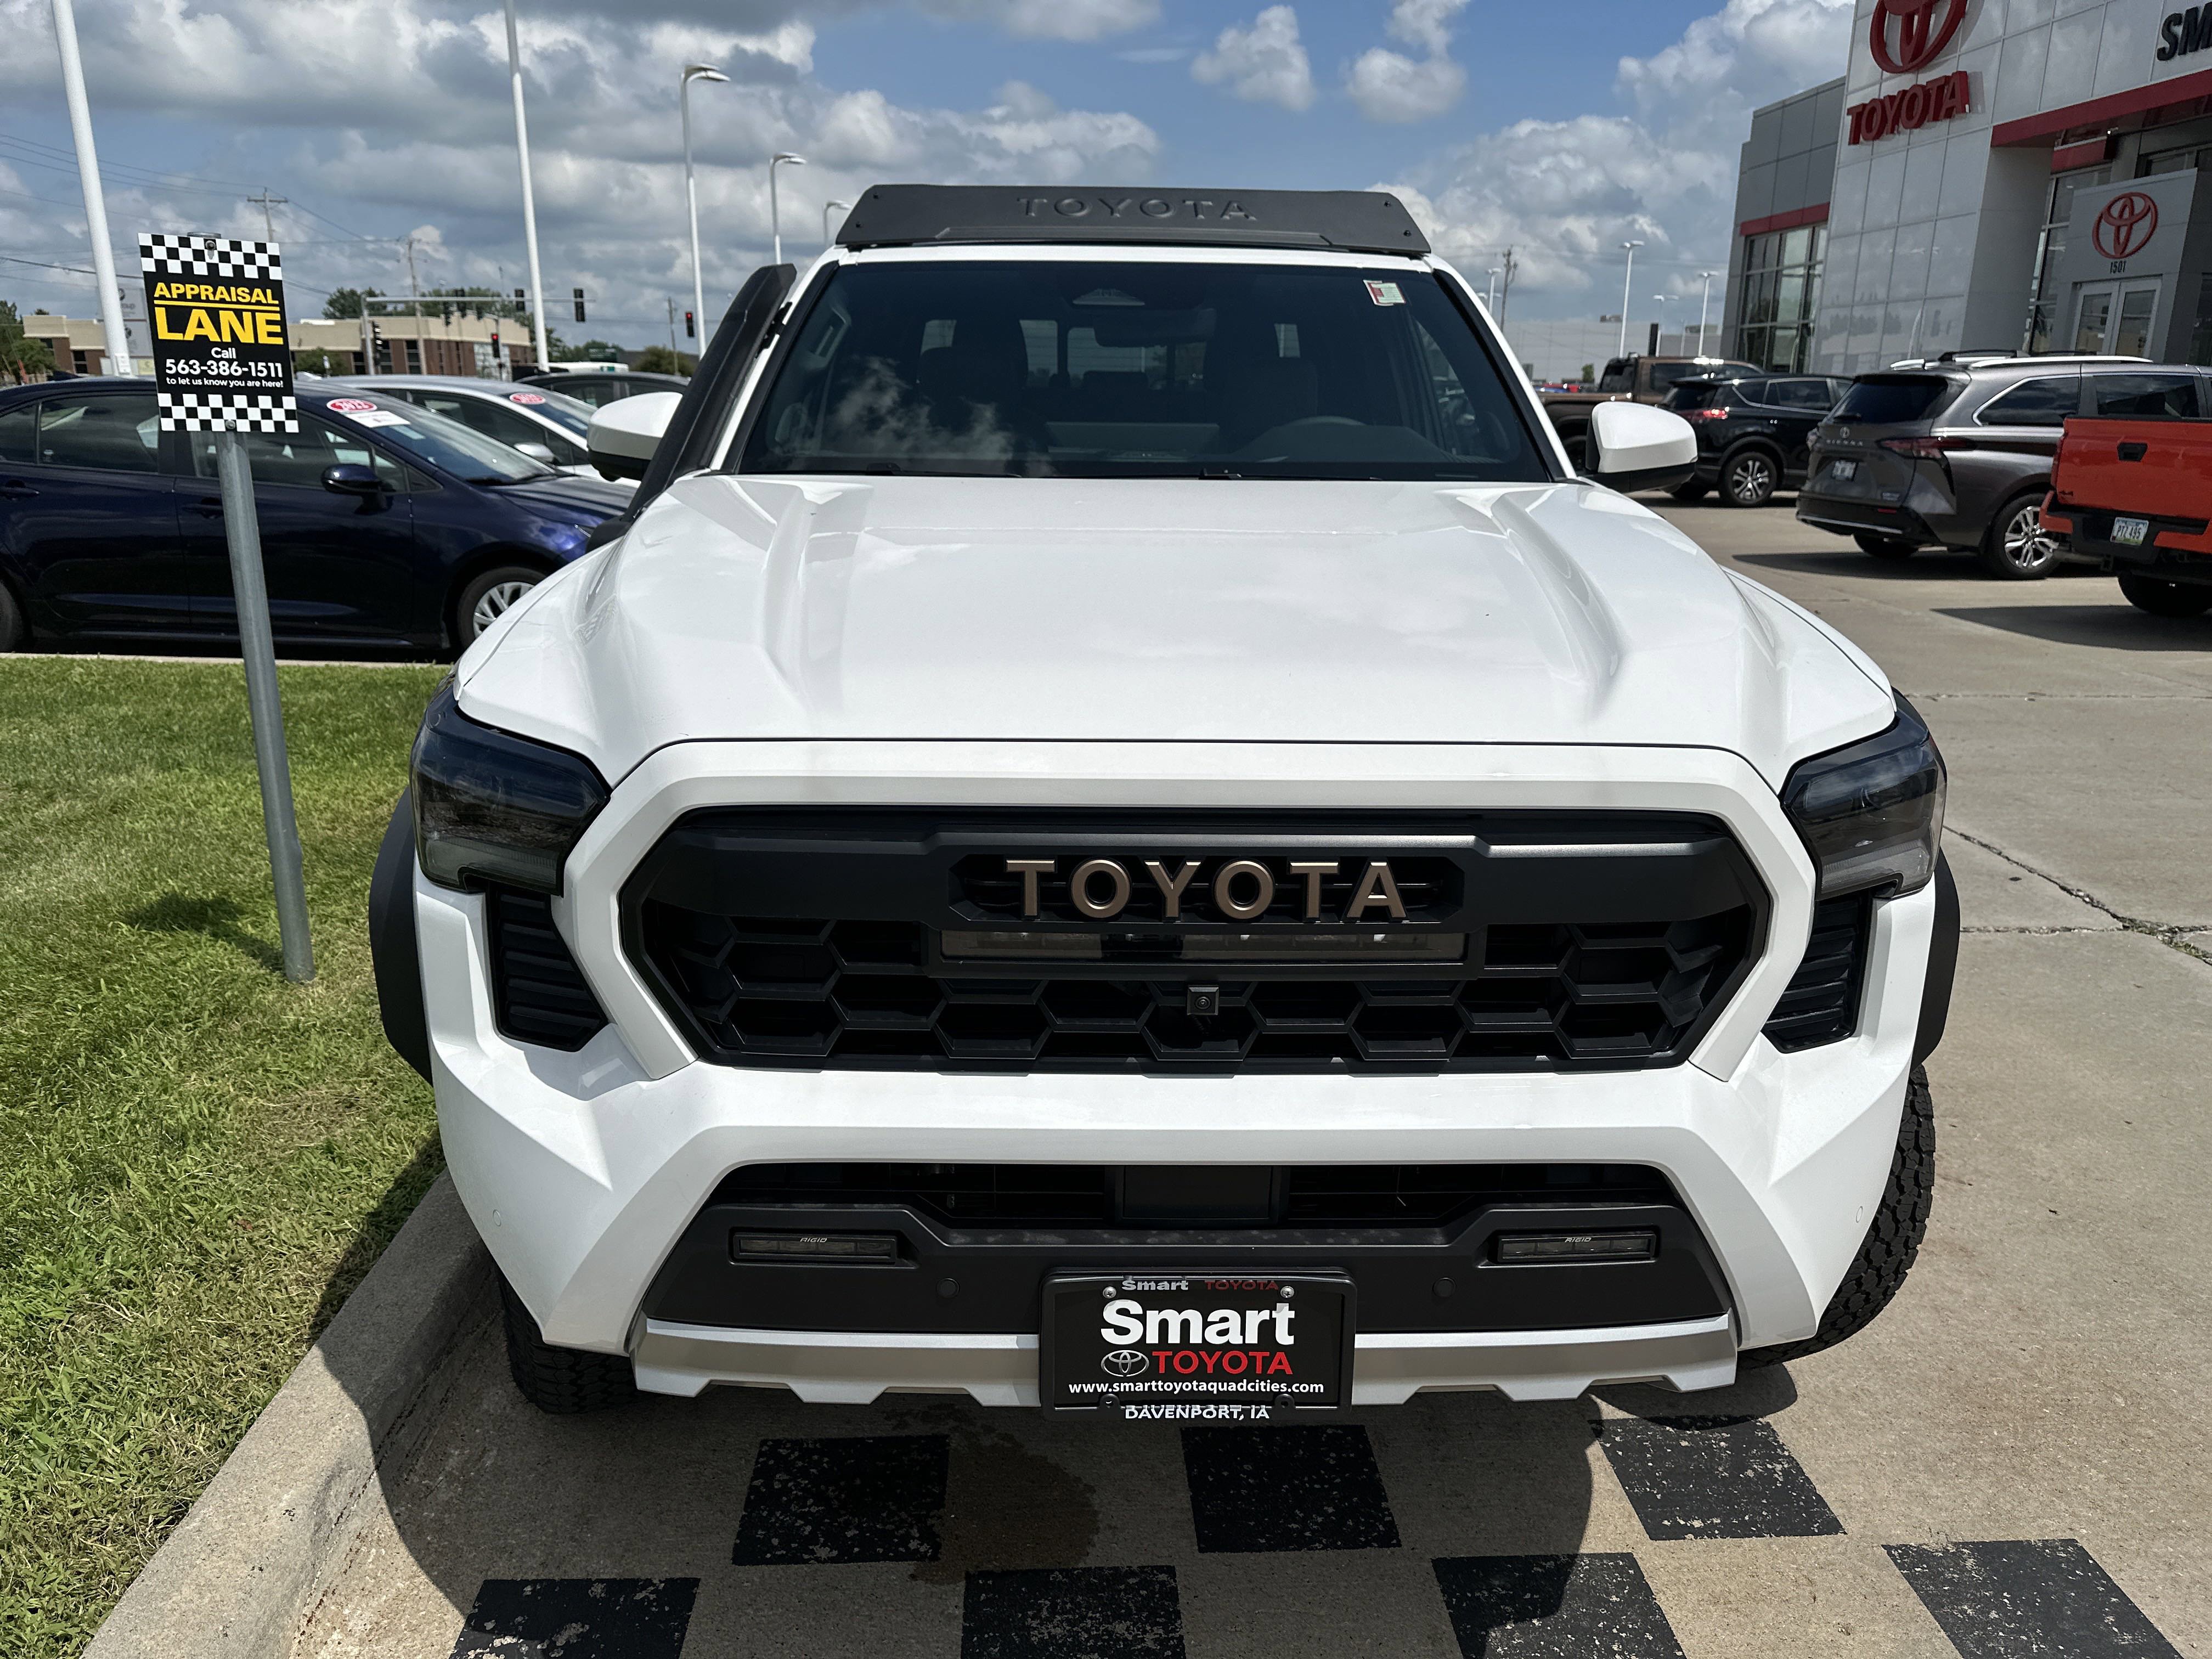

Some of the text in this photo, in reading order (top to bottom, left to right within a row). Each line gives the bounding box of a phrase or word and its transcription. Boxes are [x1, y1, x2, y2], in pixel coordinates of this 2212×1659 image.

[1847, 71, 1970, 145] TOYOTA
[1017, 198, 1257, 220] TOYOTA
[2110, 260, 2127, 274] 1501
[154, 282, 279, 304] APPRAISAL
[155, 307, 284, 345] LANE
[211, 347, 236, 359] Call
[166, 359, 283, 377] 563-386-1511
[204, 377, 228, 386] know
[1005, 860, 1406, 919] TOYOTA
[1122, 1280, 1279, 1290] Smart TOYOTA
[1101, 1299, 1295, 1345] Smart
[1153, 1350, 1293, 1375] TOYOTA
[1069, 1379, 1324, 1394] www.smarttoyotaquadcities.com
[1125, 1405, 1270, 1420] DAVENPORT, IA
